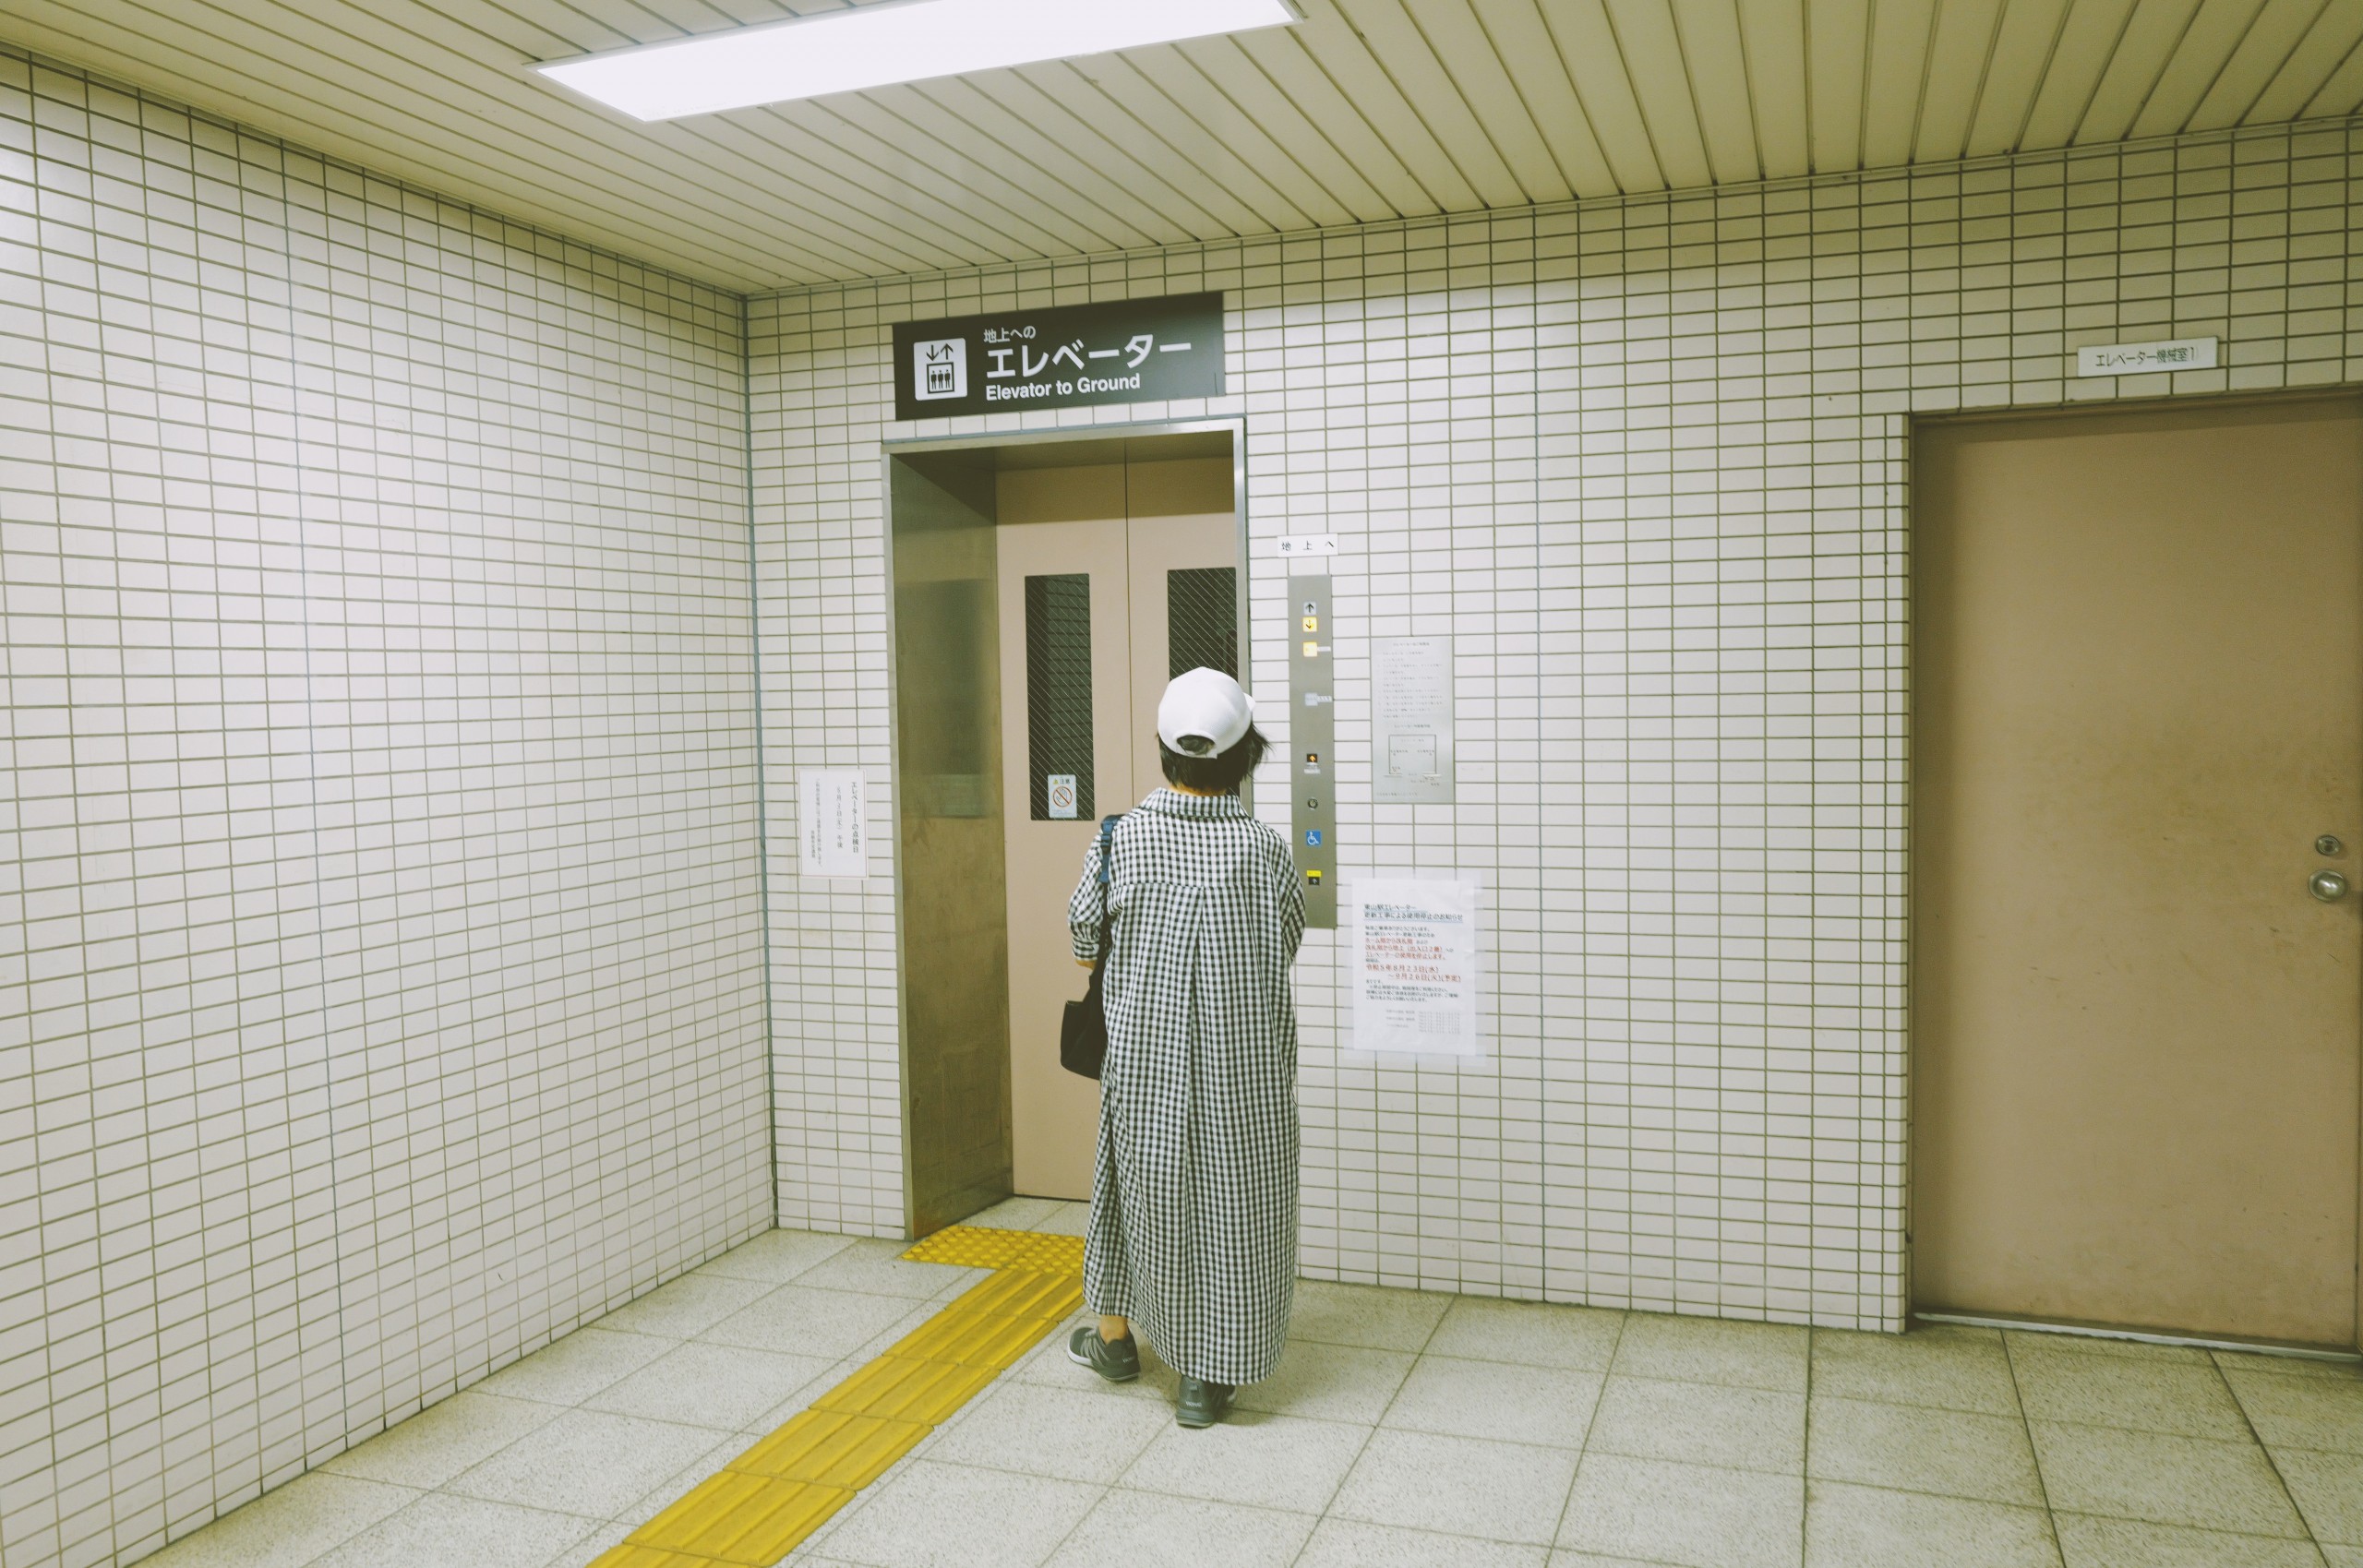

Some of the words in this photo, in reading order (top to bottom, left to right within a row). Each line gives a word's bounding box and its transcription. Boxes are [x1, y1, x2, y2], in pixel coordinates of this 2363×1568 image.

[983, 325, 1037, 343] 地上への
[987, 334, 1192, 378] エレベーター
[987, 383, 1052, 401] Elevator
[1057, 379, 1073, 395] to
[1077, 373, 1141, 394] Ground
